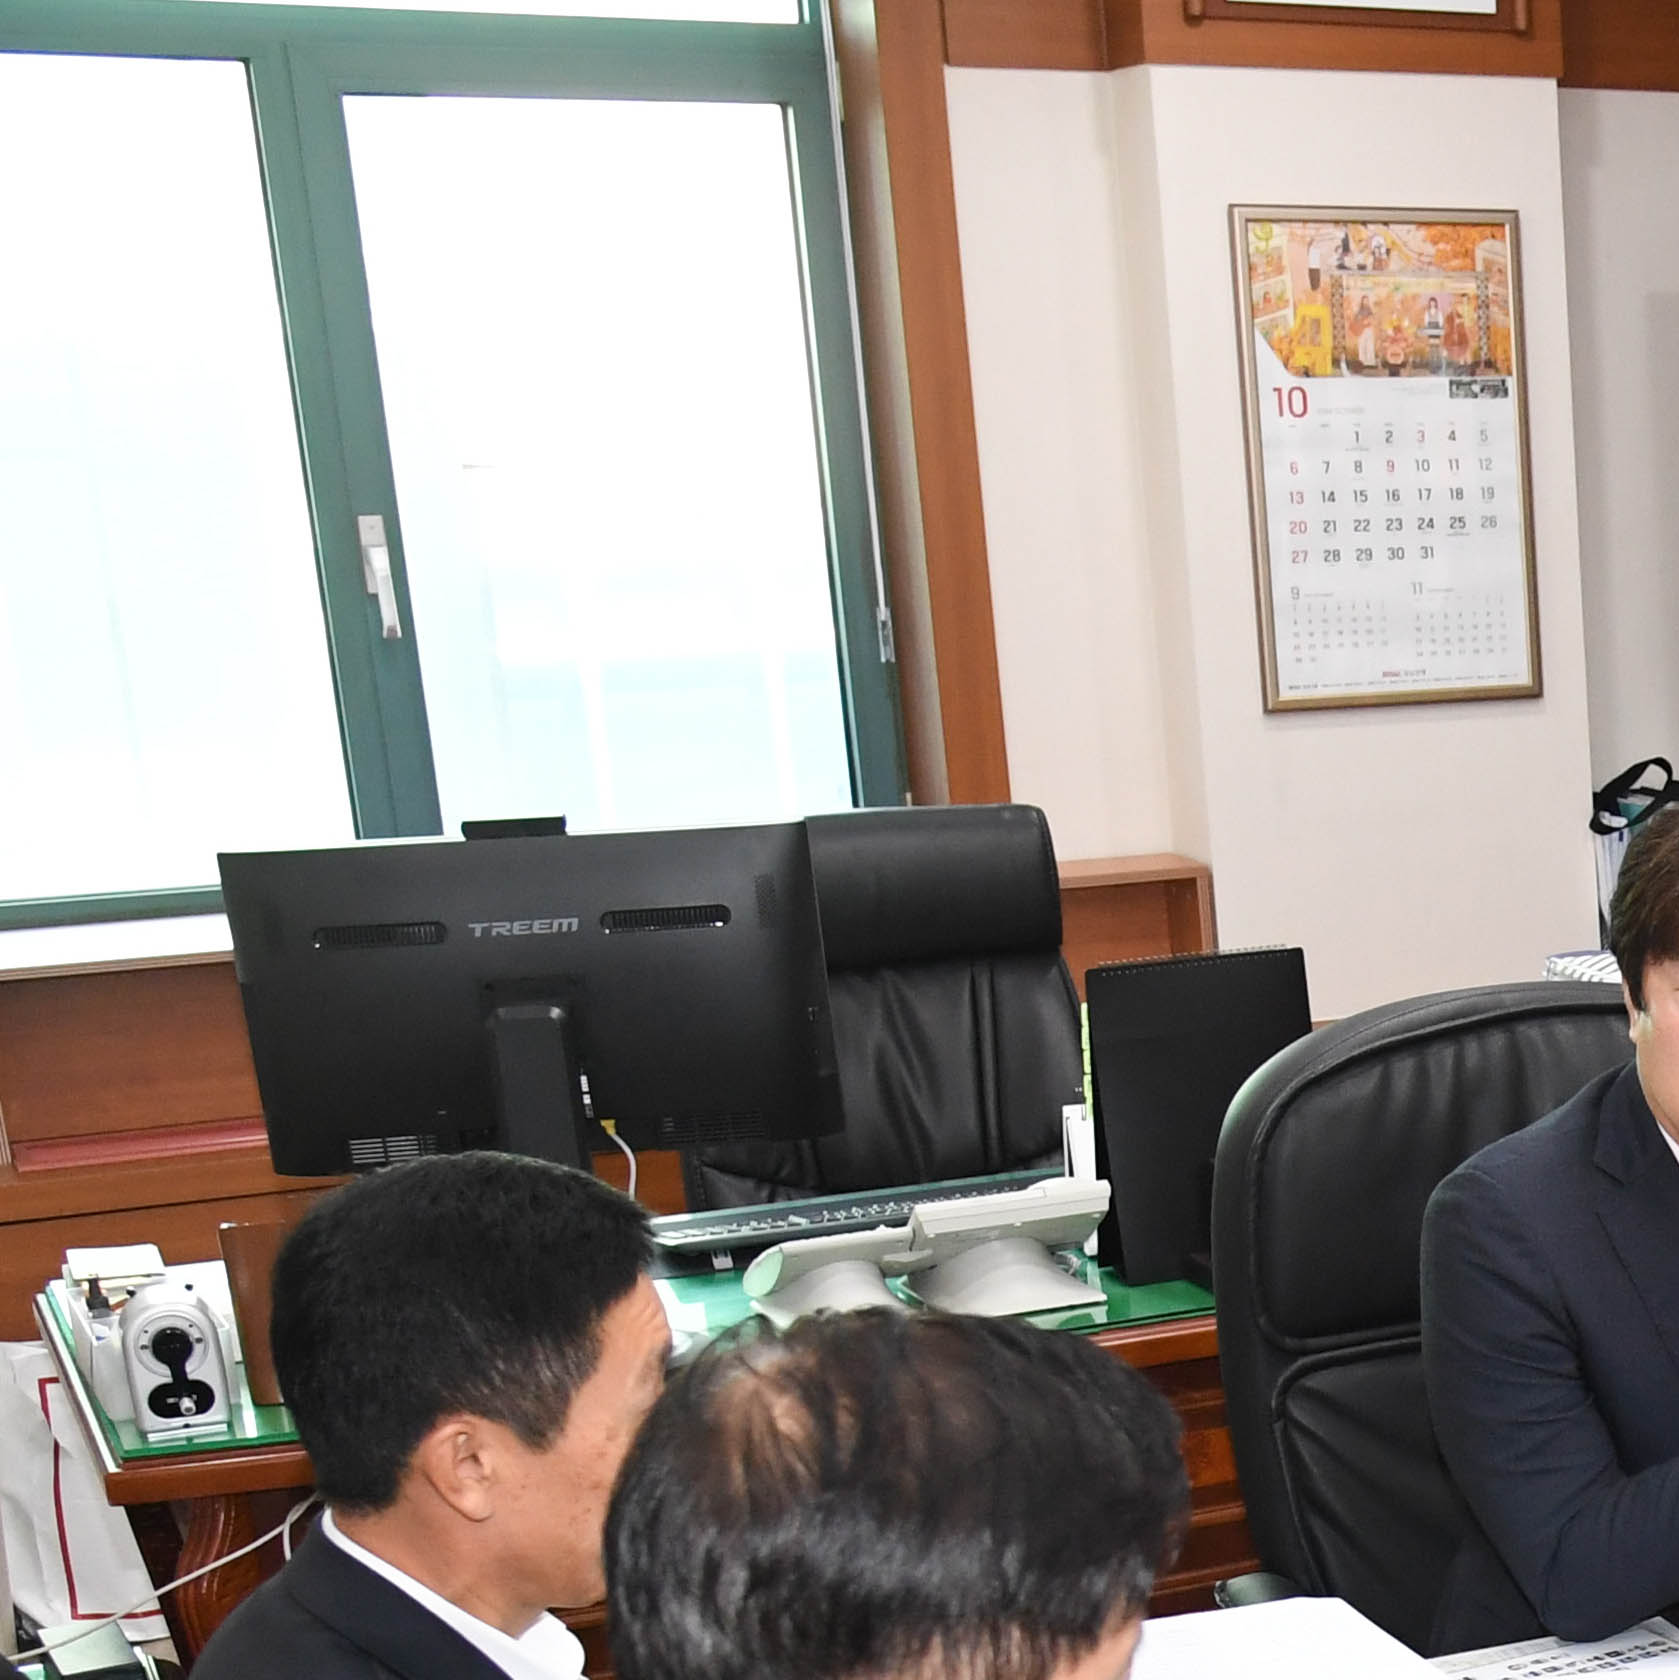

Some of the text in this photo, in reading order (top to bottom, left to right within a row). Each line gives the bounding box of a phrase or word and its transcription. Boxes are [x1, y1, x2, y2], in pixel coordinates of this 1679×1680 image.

[1272, 386, 1308, 419] 10
[1354, 428, 1489, 444] 1 2 3 4 5
[1289, 456, 1493, 476] 6 7 8 9 10 11 12
[1289, 486, 1496, 505] 13 14 15 16 17 18 19
[1289, 514, 1498, 535] 20 21 22 23 24 25 26
[1291, 545, 1435, 565] 27 28 29 30 31
[468, 917, 579, 938] TREEM
